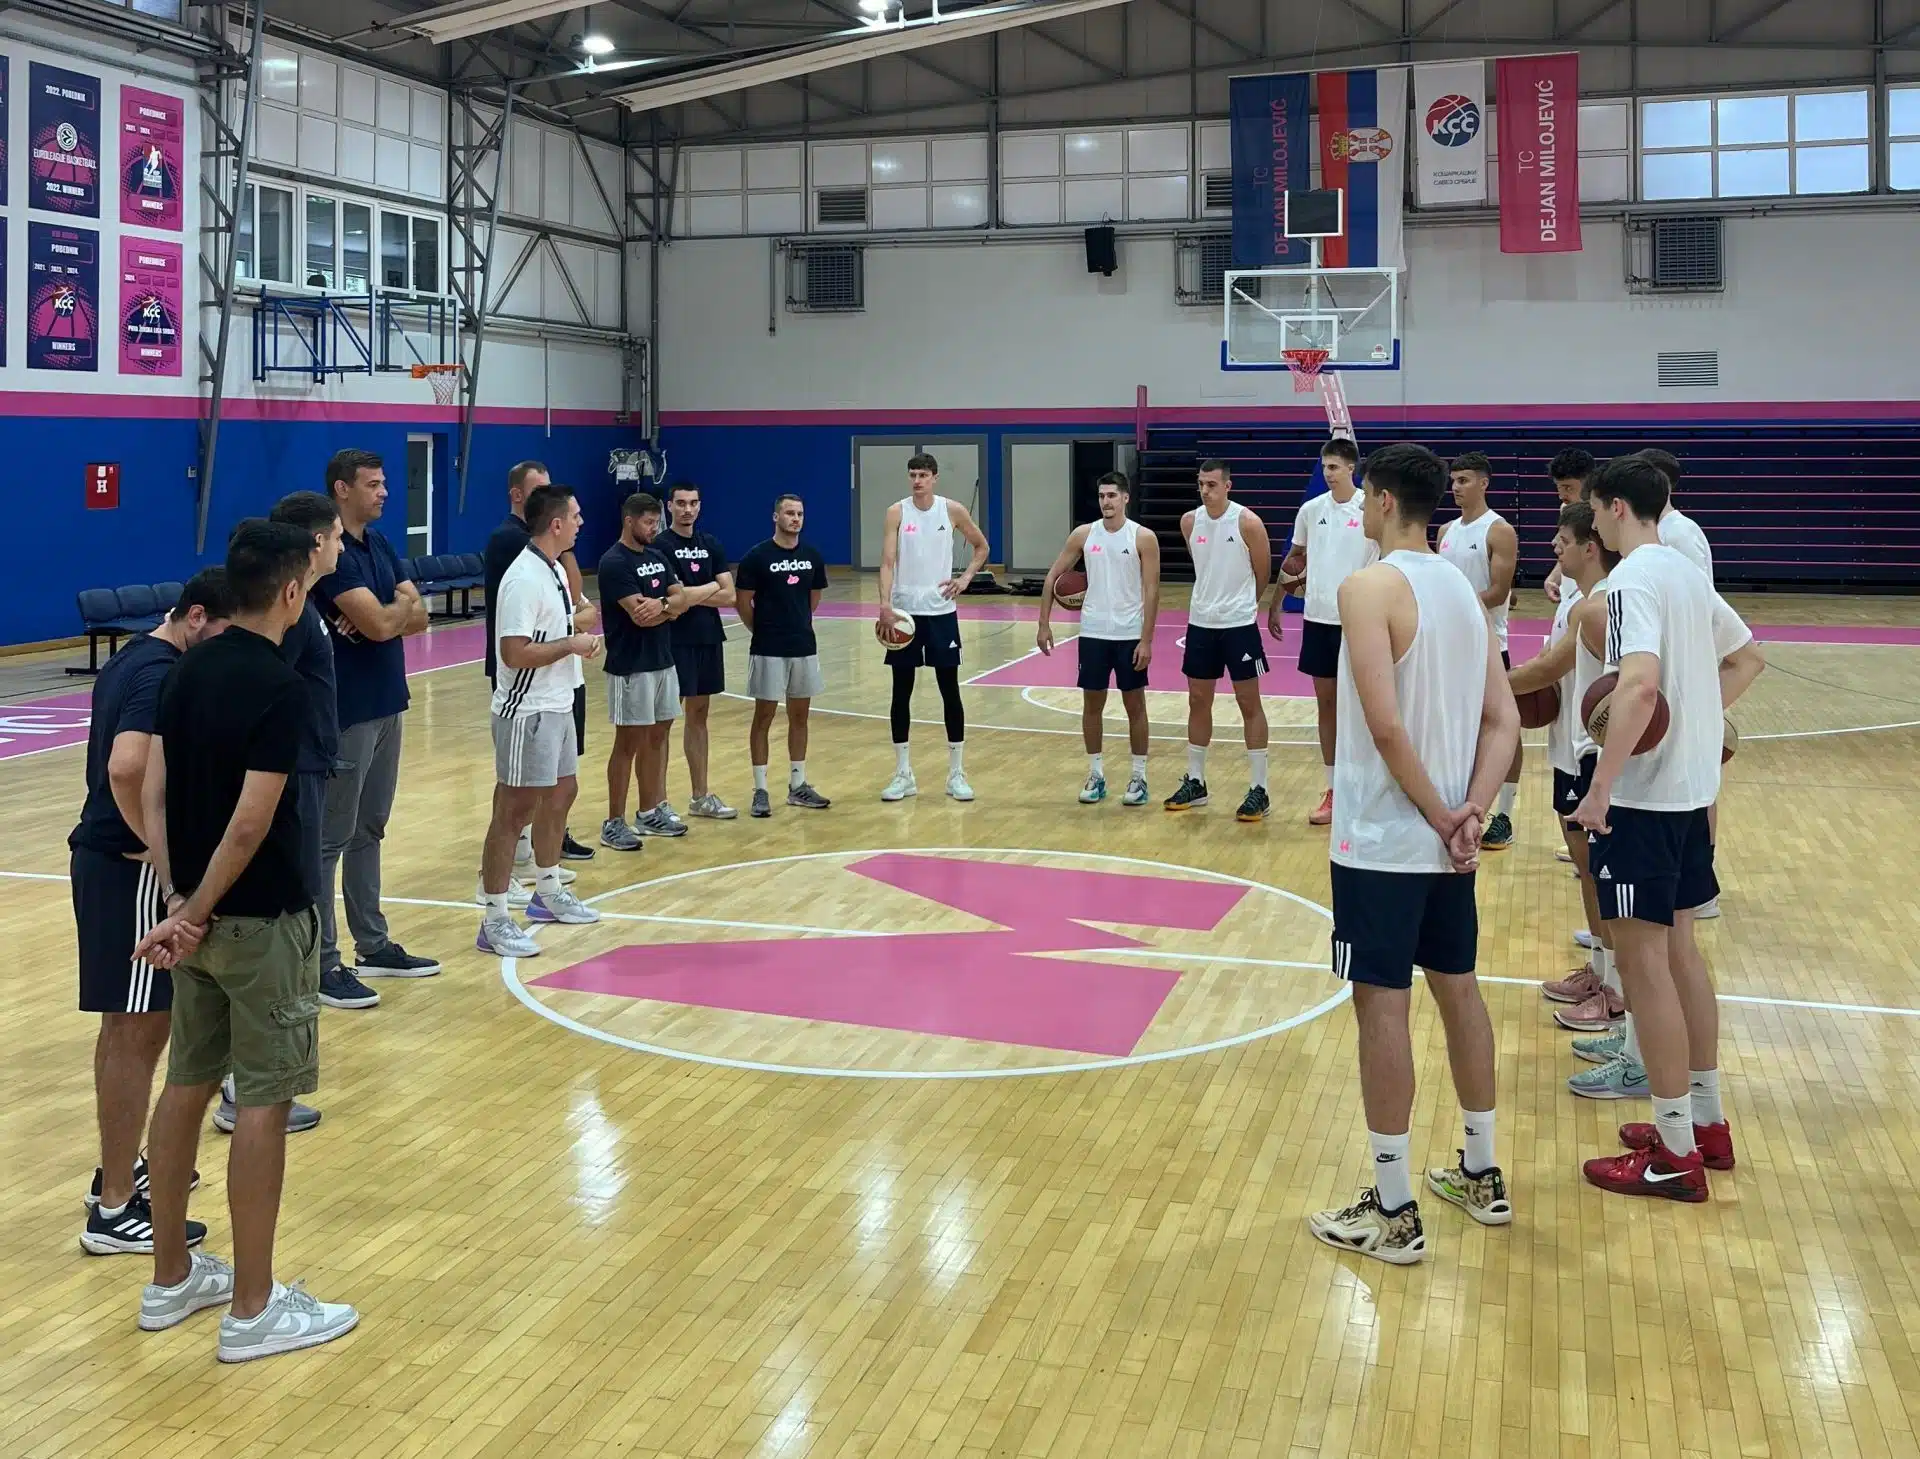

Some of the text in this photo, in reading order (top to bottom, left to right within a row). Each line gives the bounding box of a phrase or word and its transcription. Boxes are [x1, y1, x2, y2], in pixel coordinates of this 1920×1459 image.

[45, 84, 61, 96] 2022.
[1269, 98, 1288, 192] MILOJEVIĆ
[33, 148, 97, 169] EUROLEAGUE BASKETBALL
[1518, 150, 1535, 174] TC
[1535, 80, 1557, 242] DEJAN MILOJEVIĆ
[1252, 167, 1268, 190] TC
[46, 182, 84, 197] 2022. WINNERS
[52, 341, 76, 351] WINNERS
[674, 546, 709, 559] adidas
[769, 559, 812, 572] adidas
